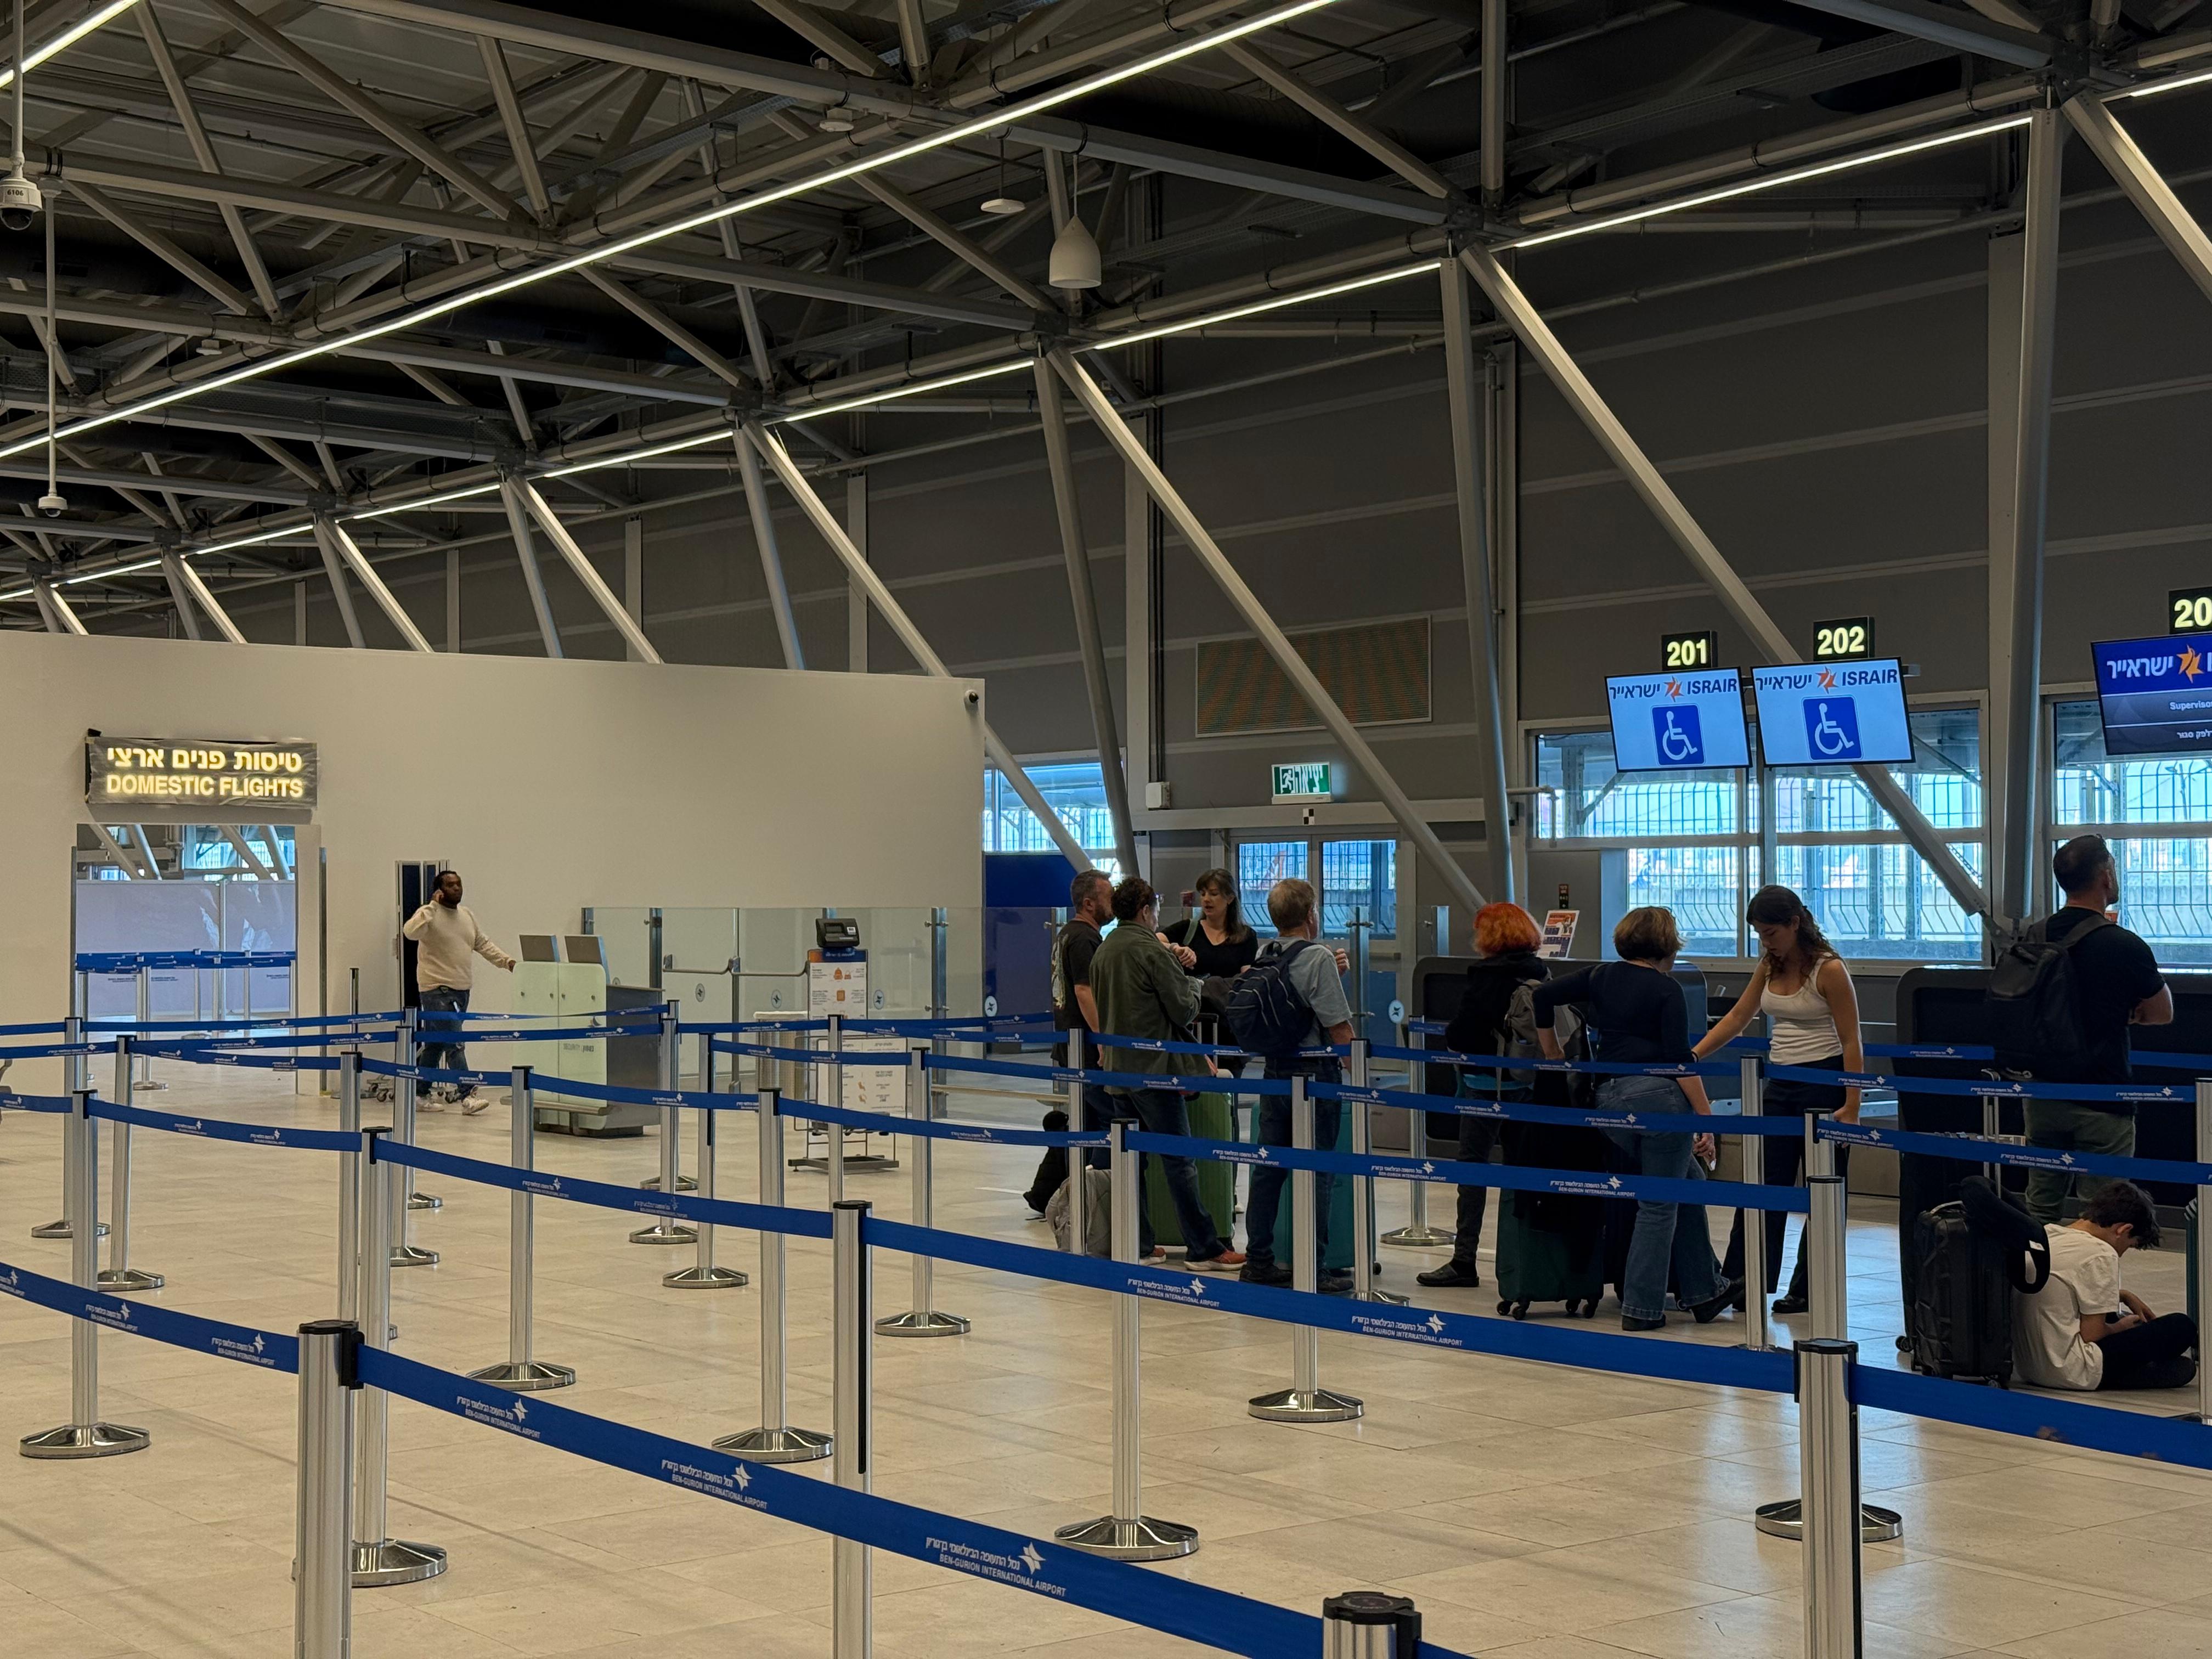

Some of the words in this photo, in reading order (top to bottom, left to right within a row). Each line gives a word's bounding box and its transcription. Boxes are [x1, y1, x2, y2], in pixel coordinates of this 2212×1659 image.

[1817, 626, 1865, 655] 202
[1666, 639, 1708, 667] 201
[1842, 669, 1898, 686] ISRAIR
[2107, 656, 2173, 679] ישראייר
[1609, 682, 1661, 699] ישראייר
[1686, 678, 1737, 696] ISRAIR
[1756, 674, 1812, 691] ישראייר
[107, 747, 165, 768] ארצי
[172, 748, 226, 769] פנים
[234, 751, 303, 772] טיסות
[106, 774, 215, 795] DOMESTIC
[219, 776, 303, 798] FLIGHTS
[1295, 765, 1323, 793] יציאה
[1363, 1326, 1395, 1336] BEN-GURION
[1396, 1331, 1438, 1342] INTERNATIONAL
[1438, 1338, 1463, 1346] AIRPORT
[672, 1474, 702, 1489] BEN-GURION
[704, 1483, 743, 1503] INTERNATIONAL
[744, 1497, 767, 1509] AIRPORT
[940, 1553, 980, 1572] BEN-GURION
[981, 1565, 1034, 1589] INTERNATIONAL
[1035, 1583, 1066, 1597] AIRPORT
